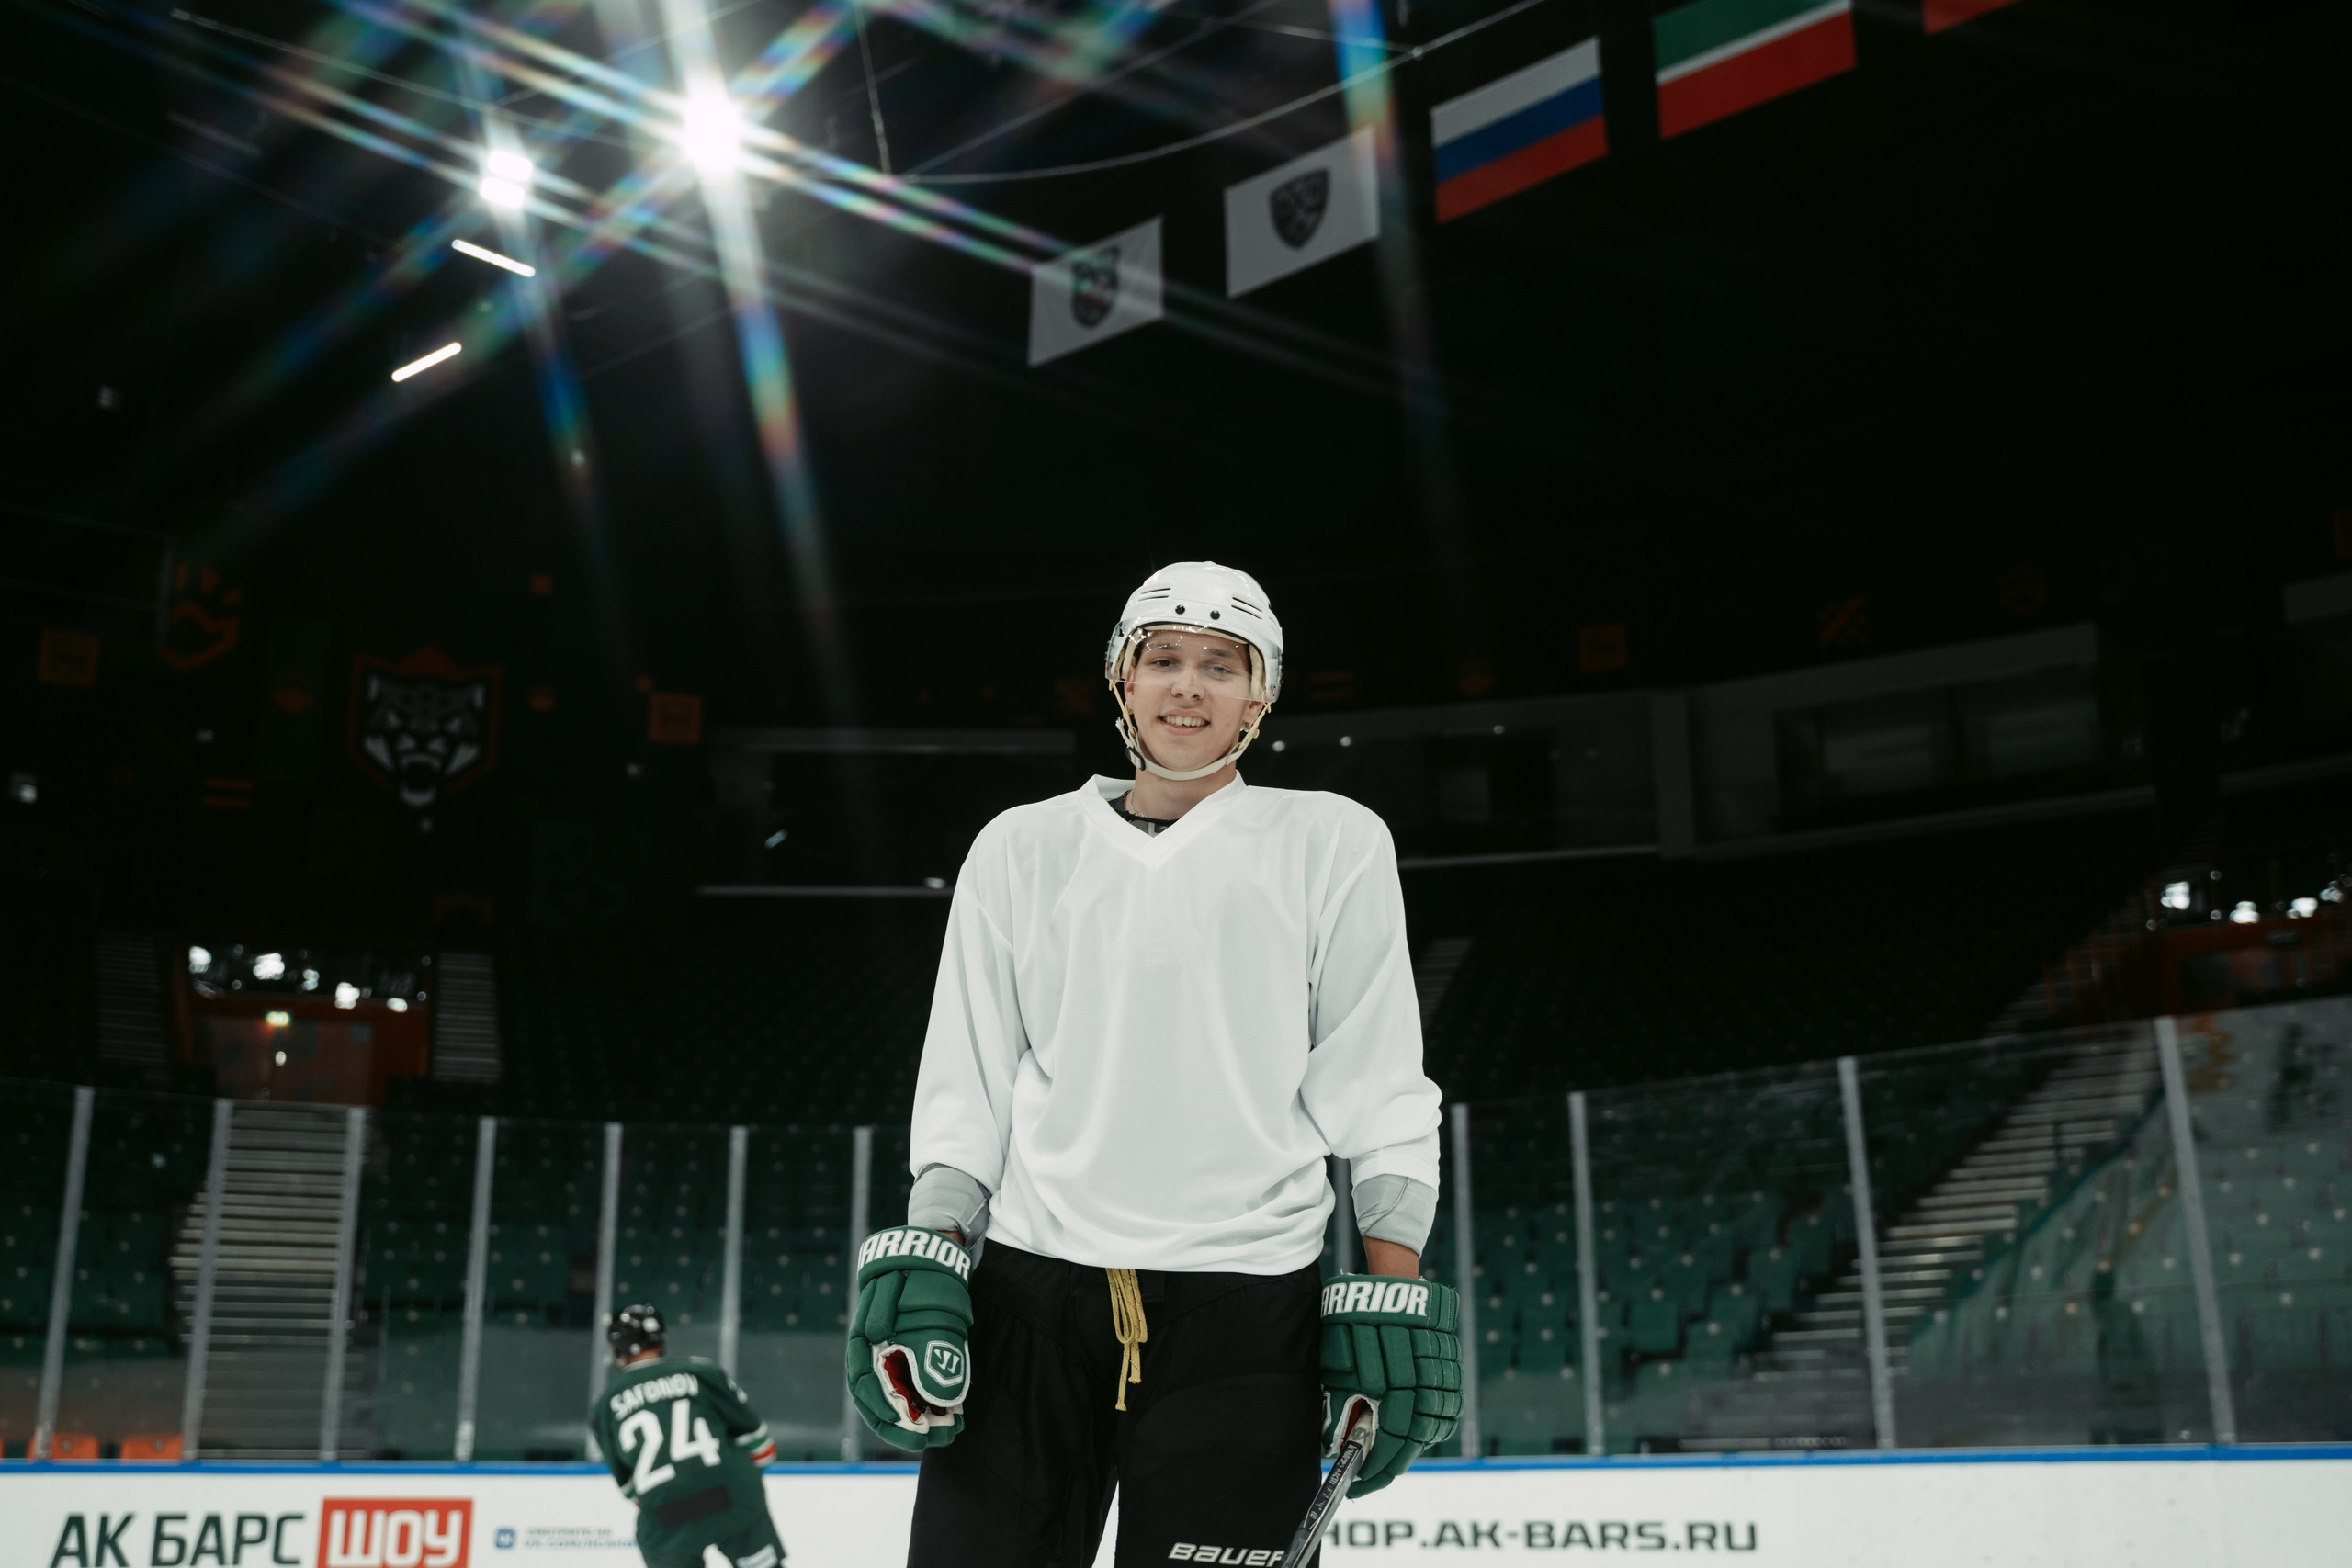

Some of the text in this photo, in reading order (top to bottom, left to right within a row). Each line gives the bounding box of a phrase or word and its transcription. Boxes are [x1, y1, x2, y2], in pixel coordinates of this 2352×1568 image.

[857, 1229, 972, 1282] ARRIOR
[1321, 1281, 1429, 1317] ARRIOR
[618, 1398, 721, 1495] 24
[51, 1509, 463, 1568] АК БАРС ШОУ
[1322, 1520, 1758, 1551] HOP.AK-BARS.RU
